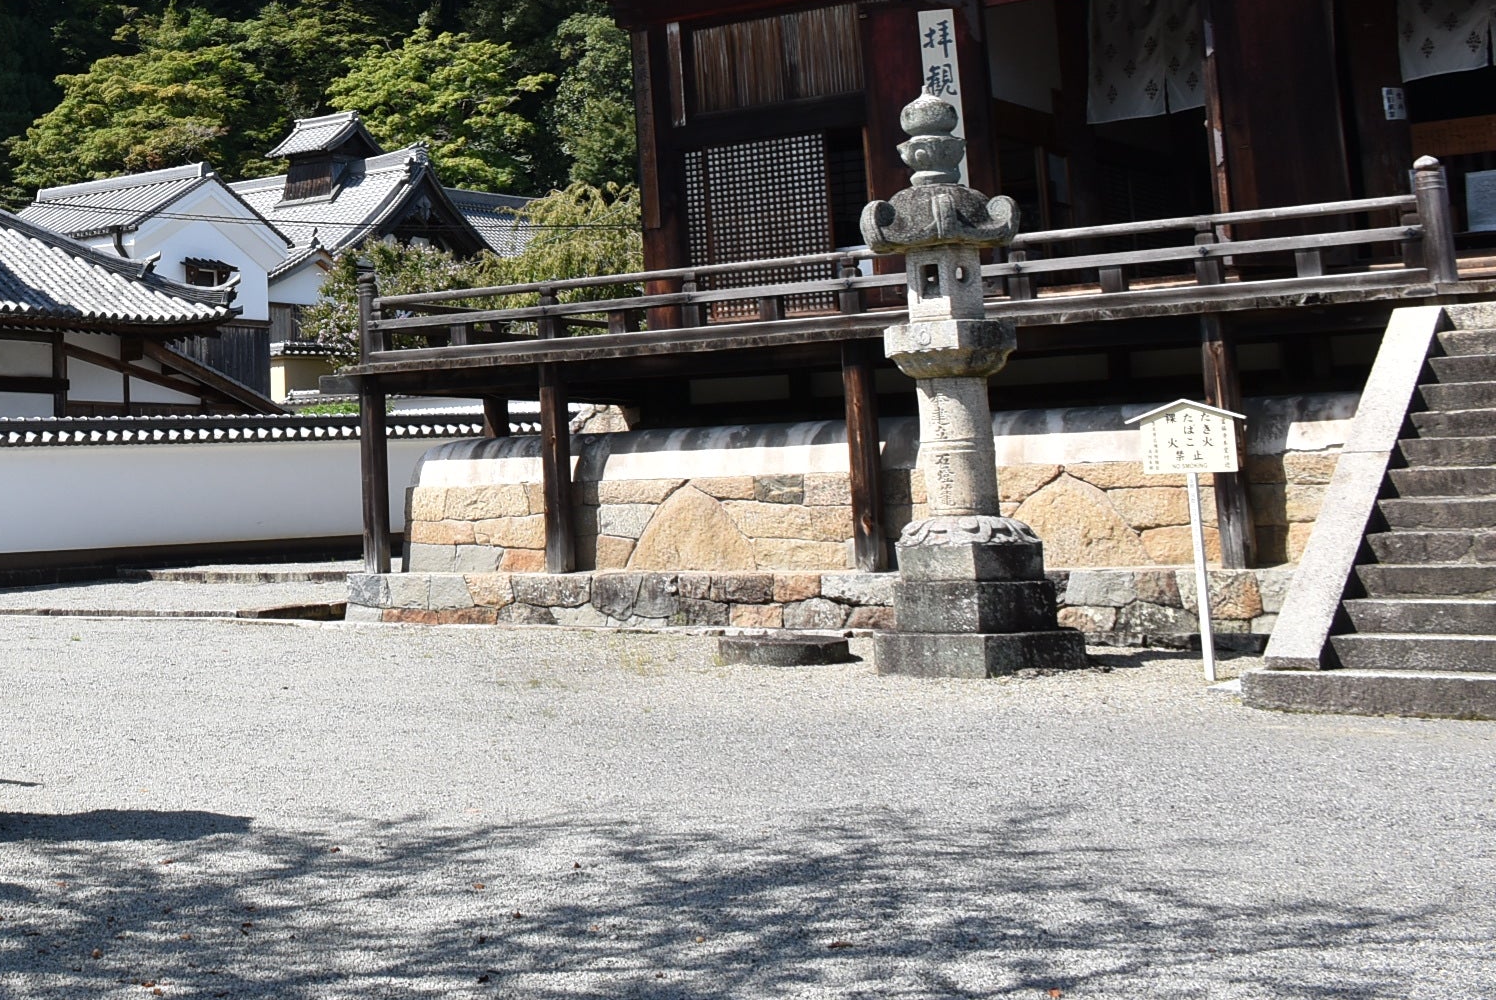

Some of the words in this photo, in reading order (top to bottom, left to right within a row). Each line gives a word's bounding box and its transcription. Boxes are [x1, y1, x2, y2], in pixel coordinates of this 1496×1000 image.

[923, 20, 957, 97] 拝観
[1183, 413, 1195, 446] たばこ
[1201, 413, 1215, 446] たき火
